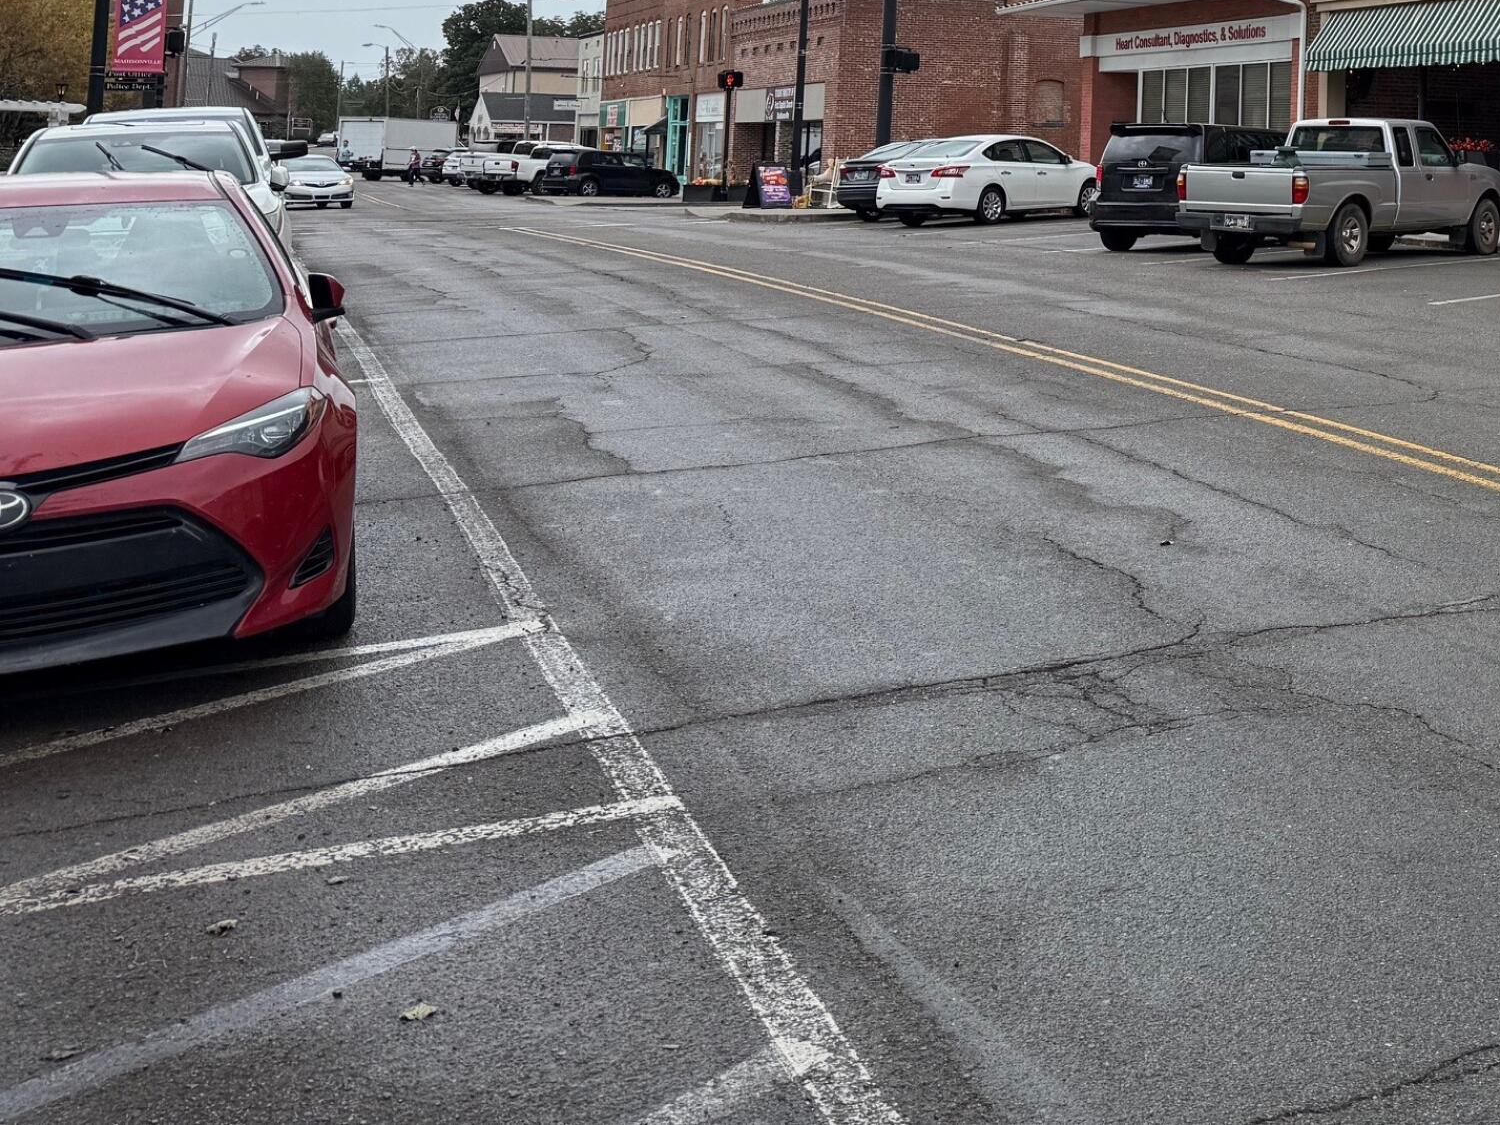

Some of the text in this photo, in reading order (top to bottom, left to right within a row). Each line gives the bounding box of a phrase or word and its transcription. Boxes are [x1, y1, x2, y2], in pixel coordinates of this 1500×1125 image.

[1115, 23, 1266, 51] Heart Consultant, Diagnostics, & Solutions
